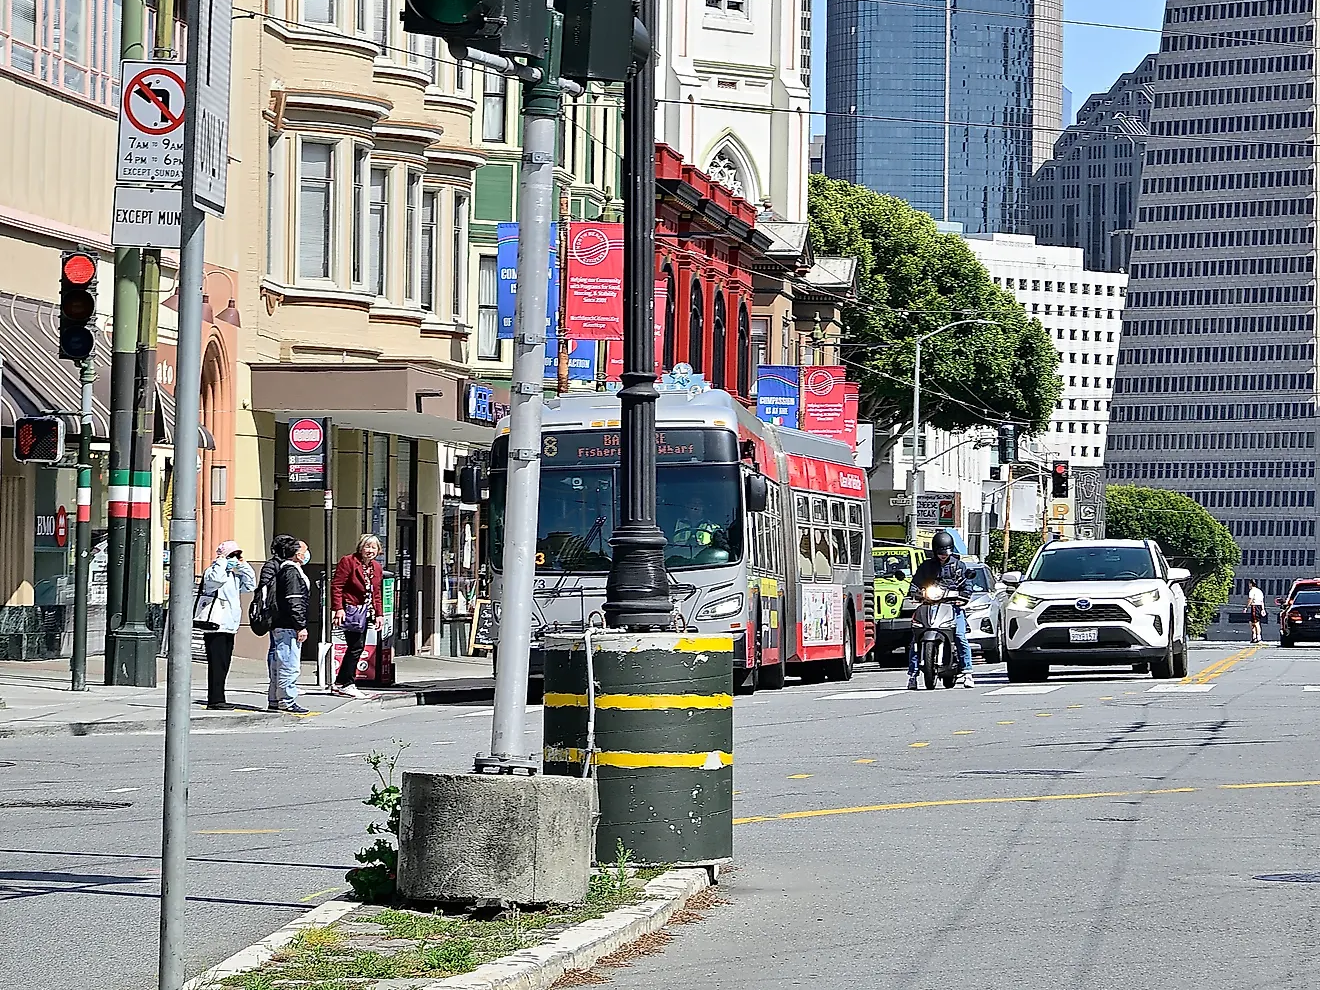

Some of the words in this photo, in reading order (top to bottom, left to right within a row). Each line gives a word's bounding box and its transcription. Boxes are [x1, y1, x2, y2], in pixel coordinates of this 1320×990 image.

[200, 107, 225, 180] ONLY
[123, 168, 151, 177] EXCEPT
[116, 209, 153, 224] EXCEPT
[158, 211, 181, 226] MUN
[156, 361, 173, 384] ato
[543, 436, 558, 457] 8
[658, 444, 694, 454] Wharf
[37, 515, 55, 536] BMO
